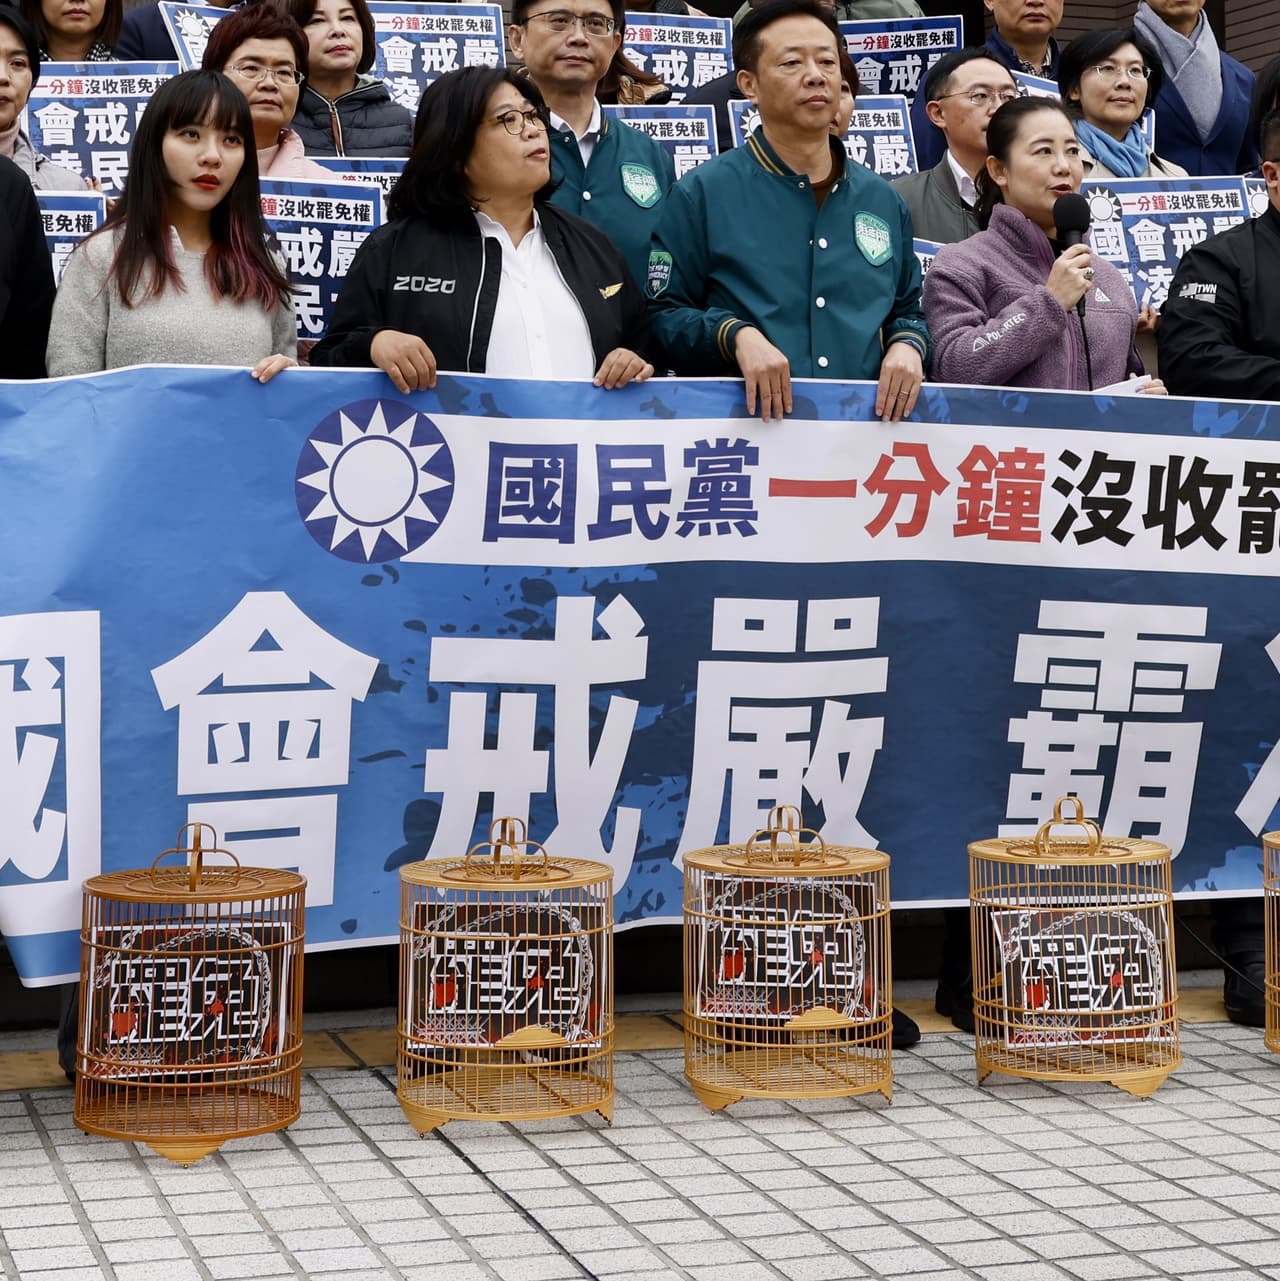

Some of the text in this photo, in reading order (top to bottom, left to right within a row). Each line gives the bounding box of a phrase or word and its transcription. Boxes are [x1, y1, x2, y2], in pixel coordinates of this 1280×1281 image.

[376, 15, 494, 33] 一分鐘沒收罷免權
[849, 32, 955, 50] 一分鐘沒收罷免權
[18, 101, 150, 146] 會戒
[1122, 190, 1241, 211] 一分鐘沒收罷免權
